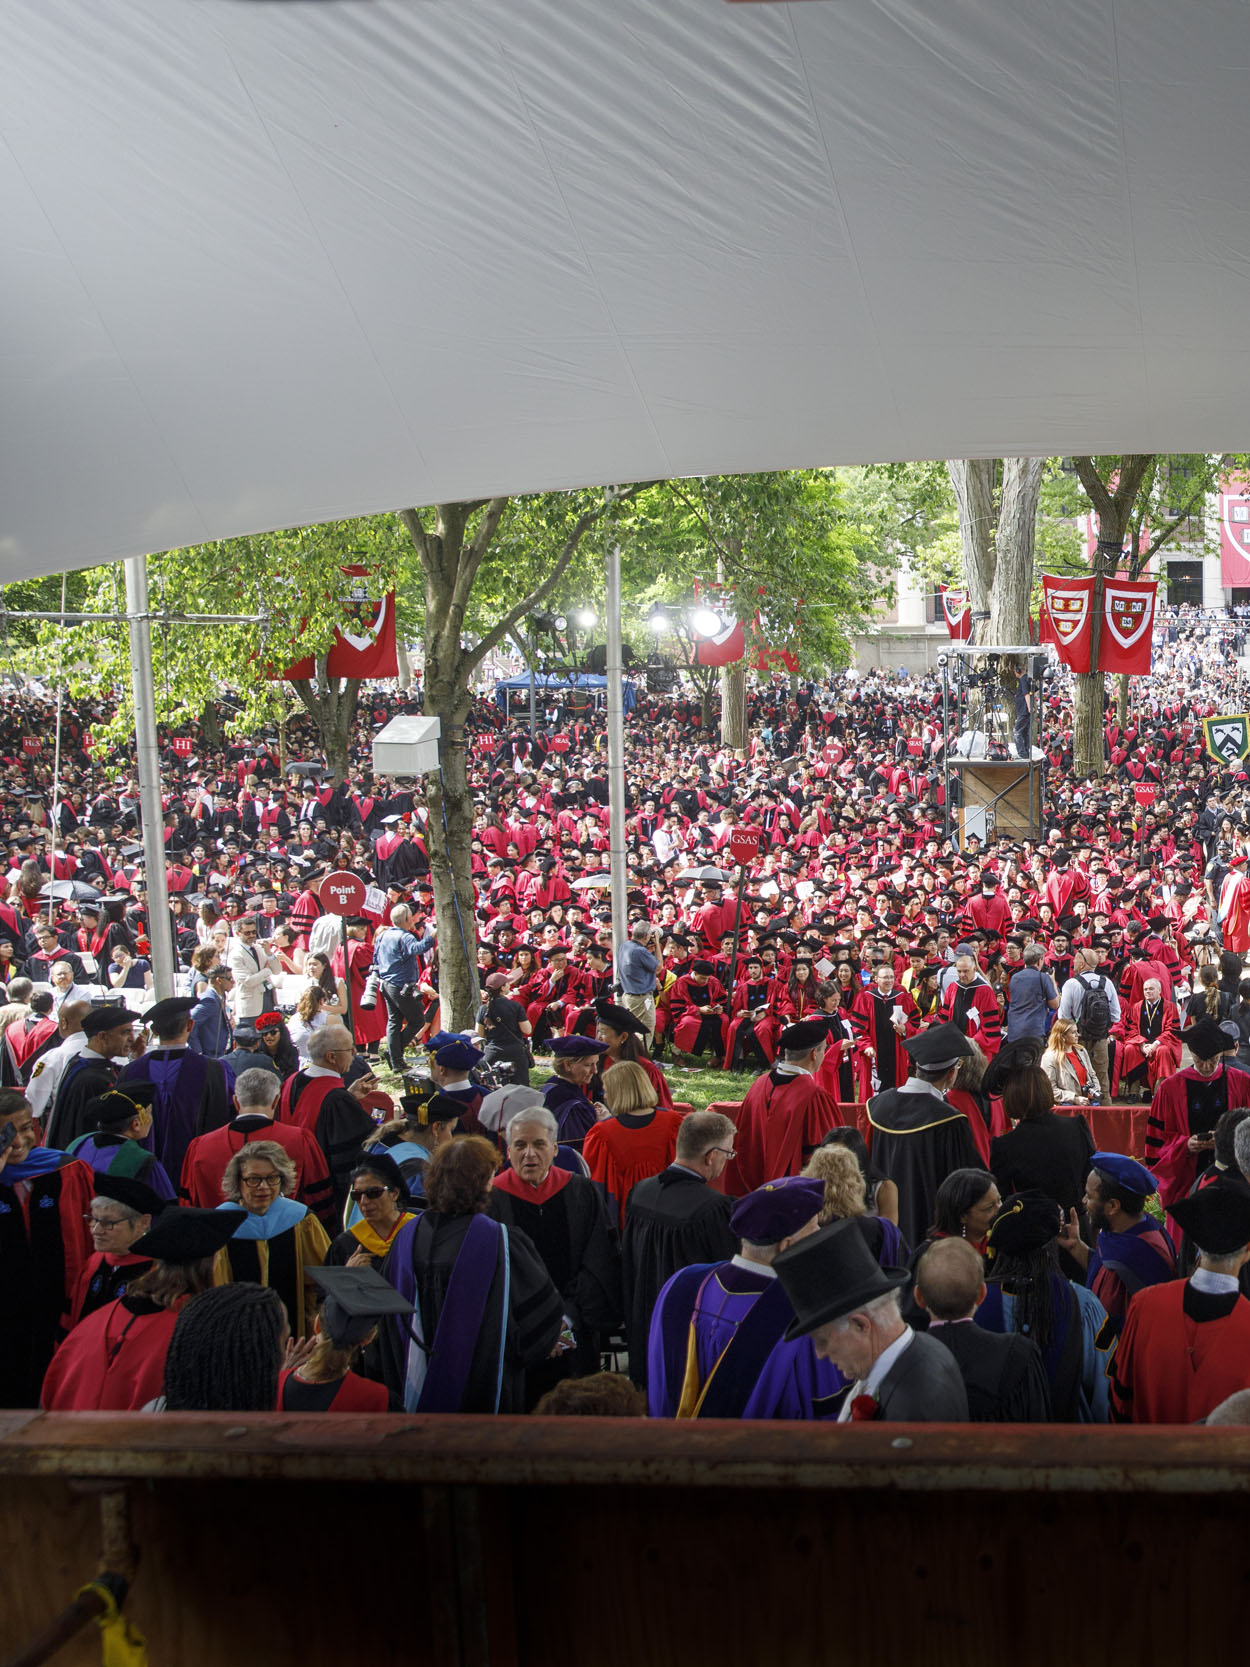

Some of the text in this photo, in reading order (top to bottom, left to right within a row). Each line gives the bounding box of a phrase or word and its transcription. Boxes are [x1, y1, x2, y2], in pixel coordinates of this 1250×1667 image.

[732, 833, 758, 846] GSAS
[330, 884, 356, 895] Point
[339, 895, 348, 905] B
